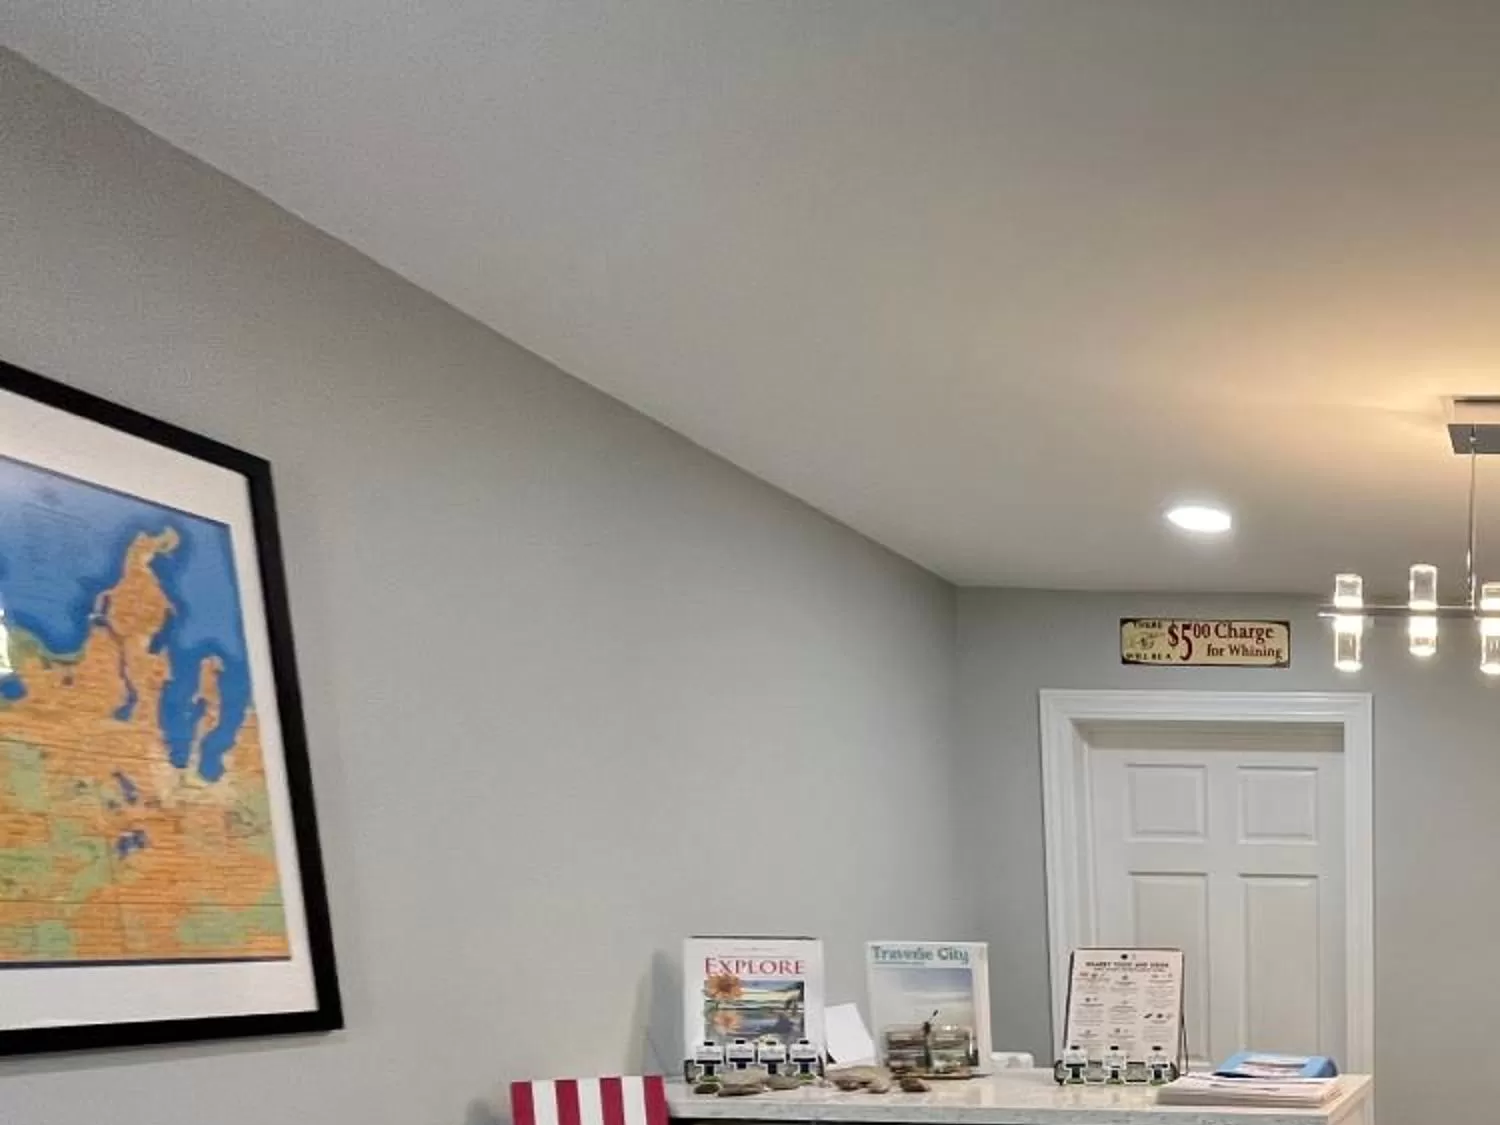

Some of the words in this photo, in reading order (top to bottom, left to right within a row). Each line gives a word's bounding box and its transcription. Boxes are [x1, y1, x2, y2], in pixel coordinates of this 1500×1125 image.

[1214, 621, 1274, 645] Charge
[1206, 643, 1226, 657] for
[1227, 643, 1283, 660] Whining
[937, 946, 969, 964] City
[704, 957, 806, 975] EXPLORE
